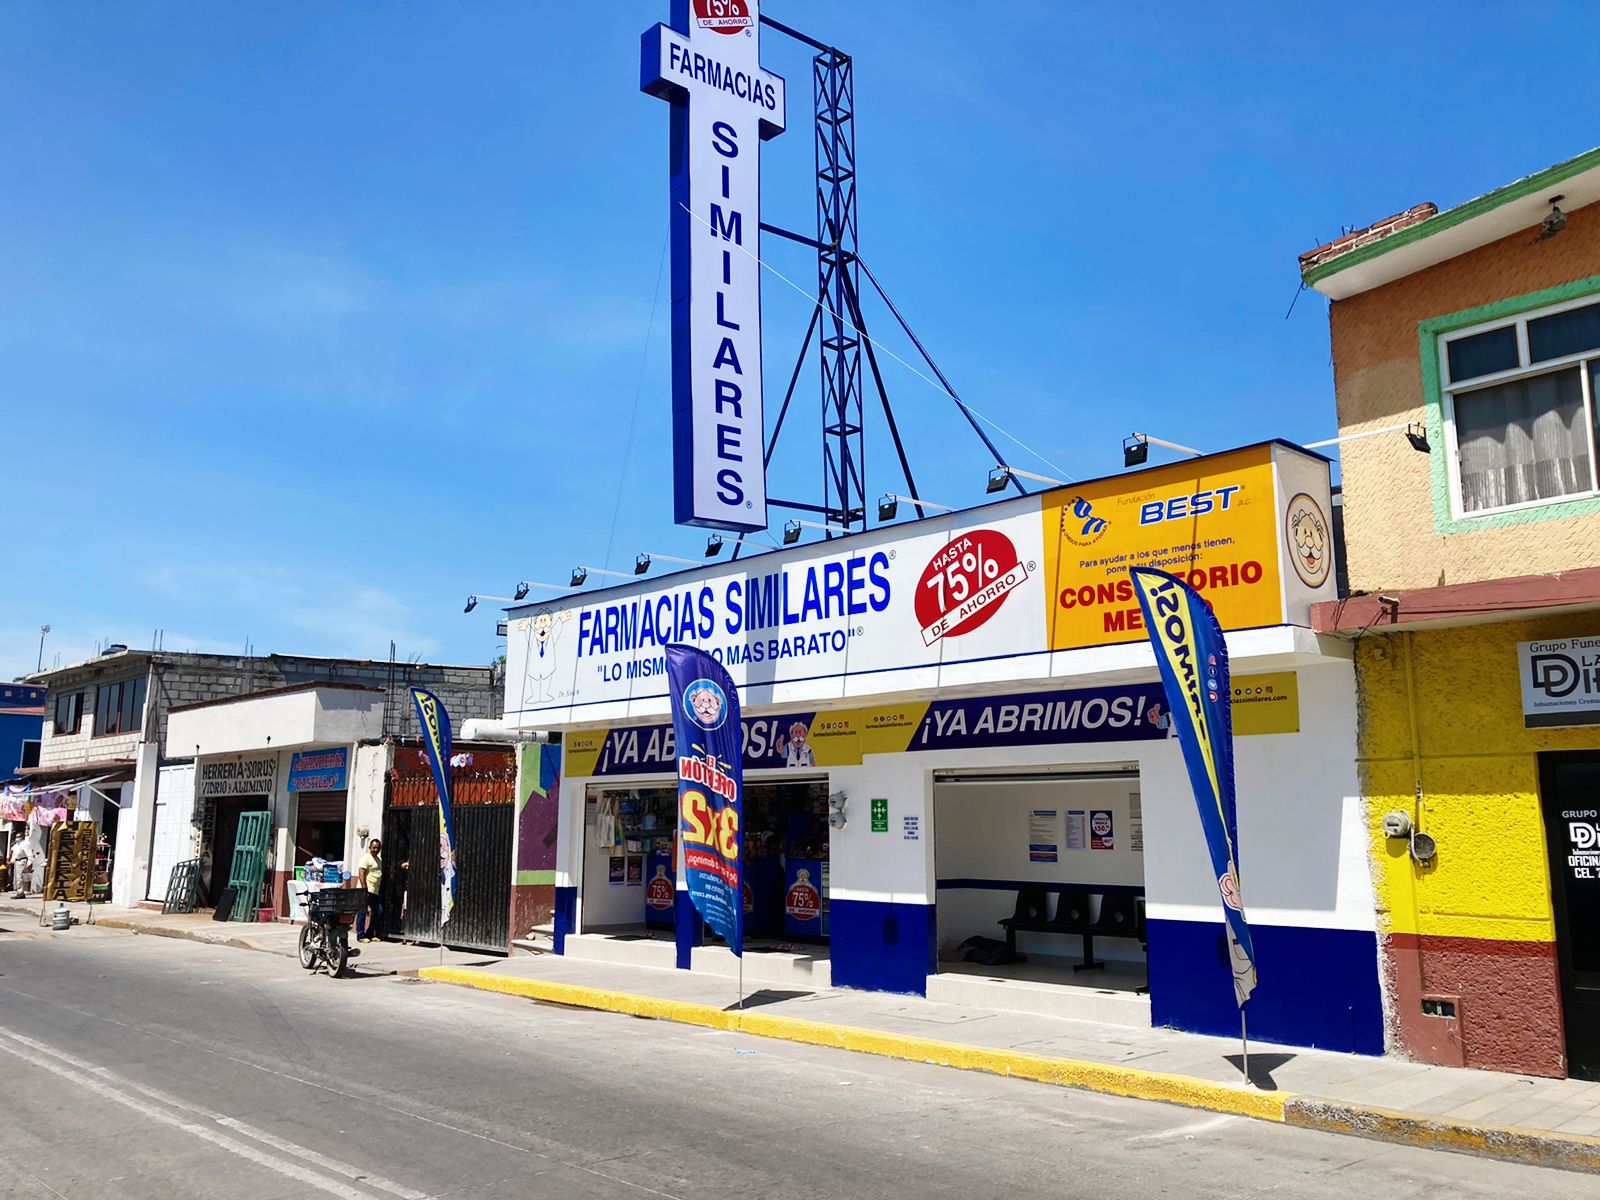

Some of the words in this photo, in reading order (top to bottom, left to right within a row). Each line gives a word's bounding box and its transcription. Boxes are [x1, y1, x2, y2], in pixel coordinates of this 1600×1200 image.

[670, 42, 776, 111] FARMACIAS
[710, 121, 744, 506] SIMILARES
[1139, 485, 1240, 526] BEST
[932, 537, 972, 571] HASTA
[1079, 559, 1098, 568] Para
[1100, 554, 1127, 567] ayudar
[1136, 550, 1150, 559] los
[1152, 546, 1169, 559] que
[1171, 543, 1201, 554] menos
[1203, 536, 1235, 549] tienen,
[1106, 564, 1127, 576] pone
[1149, 552, 1203, 569] disposición:
[926, 543, 999, 614] 75%
[1060, 560, 1263, 609] CONSORIO
[577, 586, 715, 658] FARMACIAS
[725, 551, 891, 635] SIMILARES
[931, 618, 950, 637] DE
[959, 573, 1016, 619] AHORRO
[597, 662, 621, 682] "LO
[627, 656, 669, 679] MISM
[727, 645, 765, 666] MAS
[768, 628, 855, 660] BARATO"
[1529, 642, 1567, 652] Grupo
[1230, 695, 1288, 704] ciassimilares.com
[923, 703, 967, 744] ¡YA
[972, 696, 1147, 735] ABRIMOS!
[602, 730, 639, 772] ¡YA
[202, 762, 244, 780] HERRERIA
[202, 781, 227, 795] VIDRIO
[232, 778, 272, 793] ALUMINIO
[1562, 810, 1598, 818] GRUPO
[1574, 867, 1595, 878] CEL.
[652, 885, 669, 898] 75%
[792, 892, 814, 907] 75%
